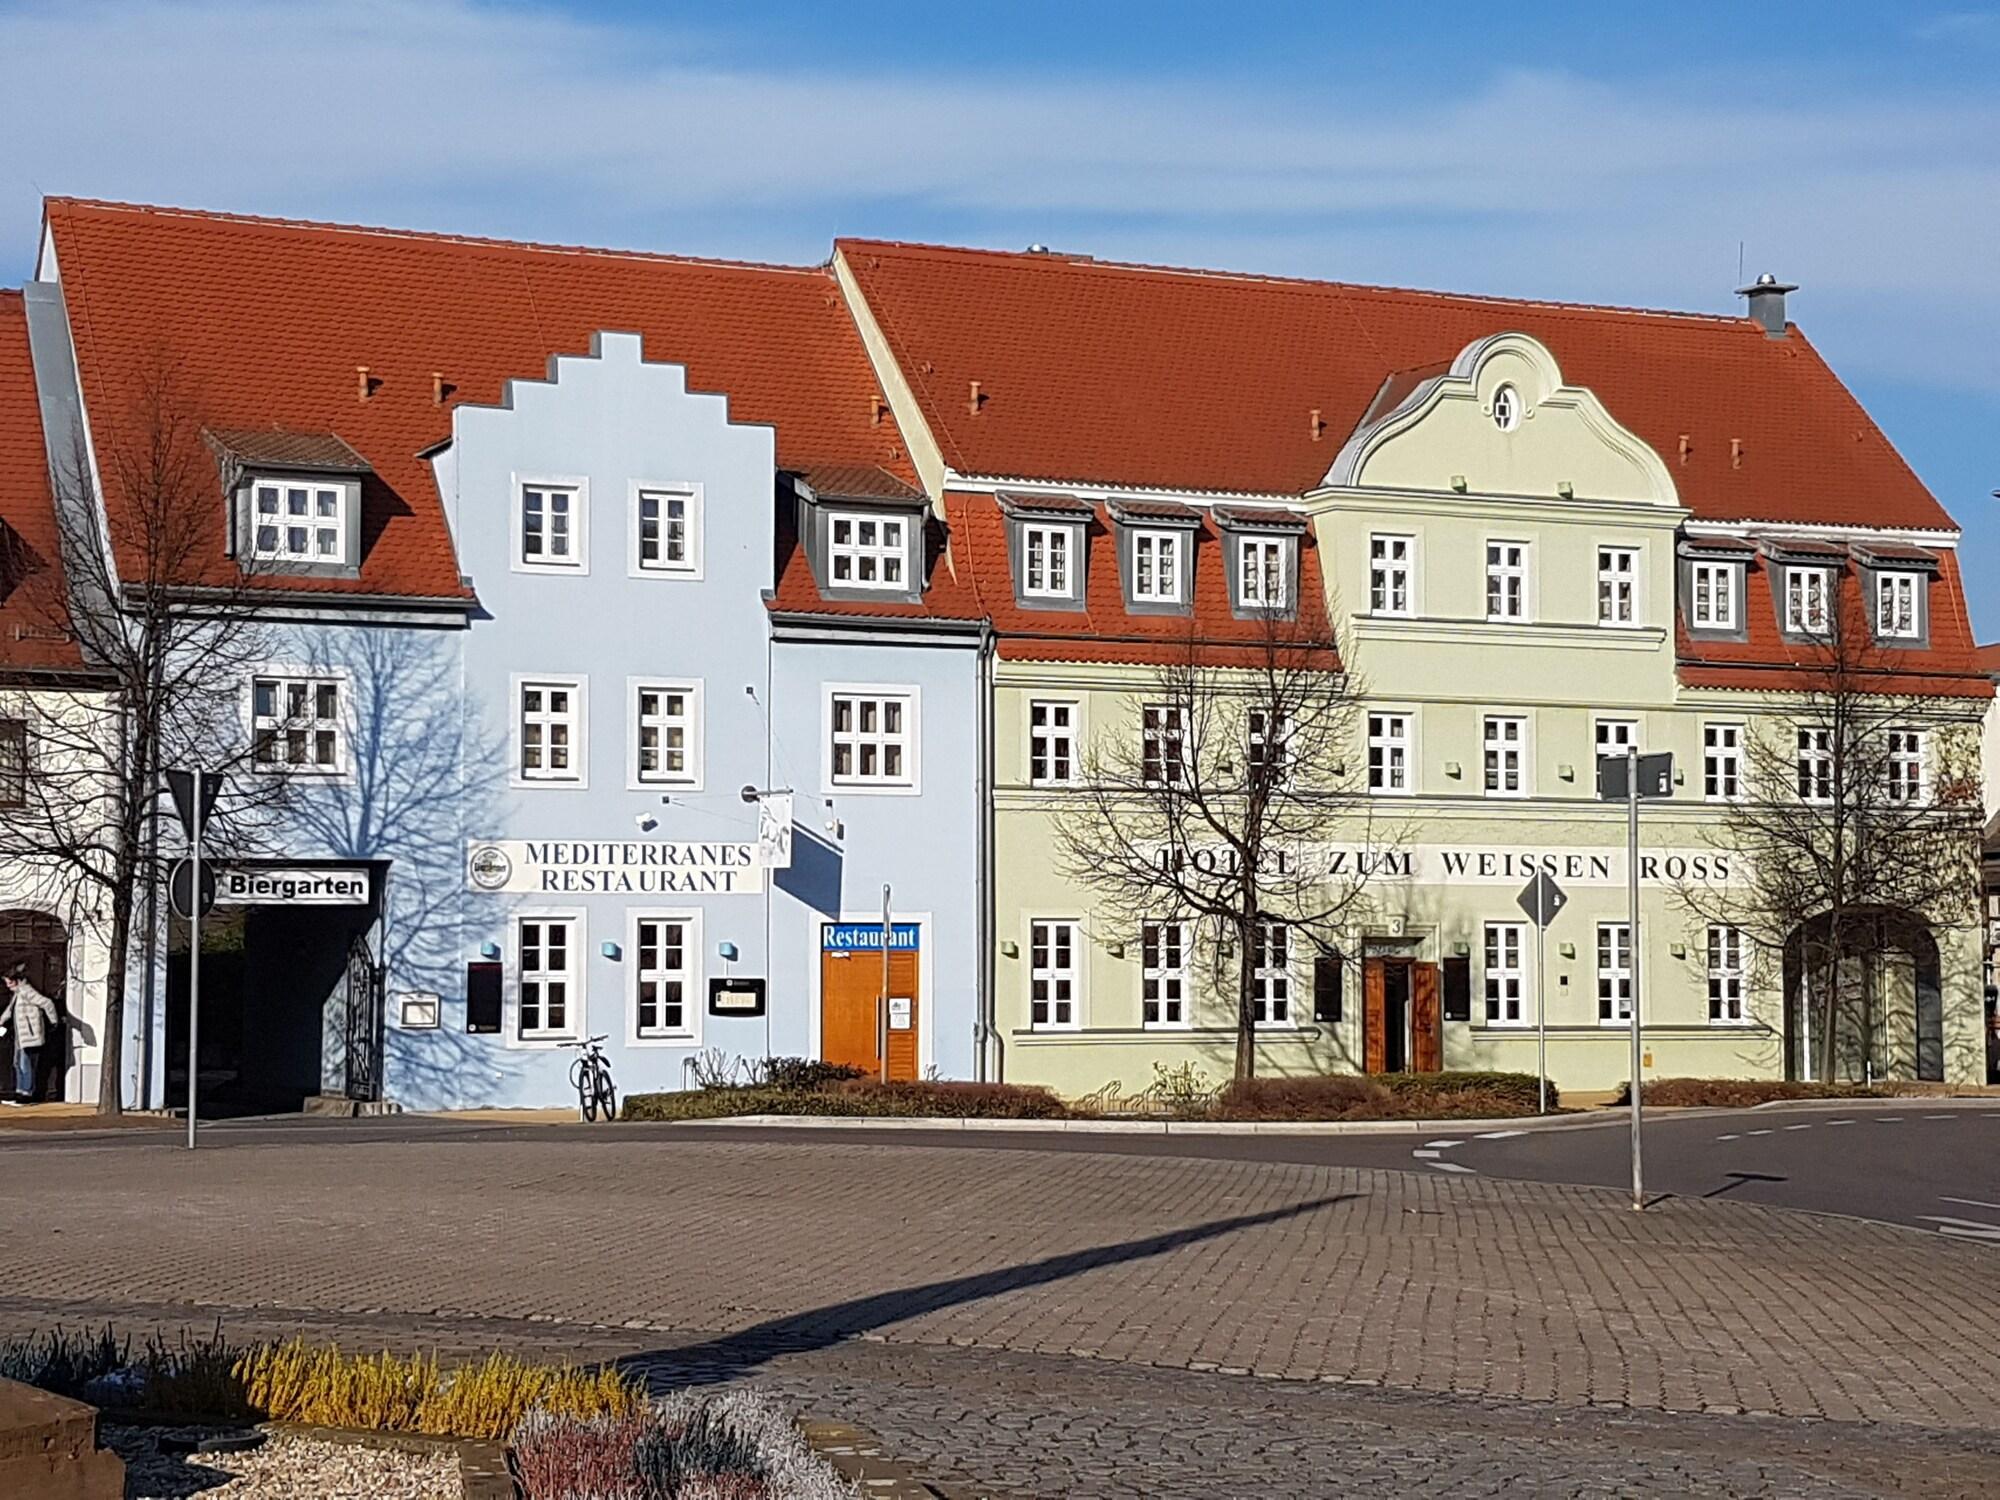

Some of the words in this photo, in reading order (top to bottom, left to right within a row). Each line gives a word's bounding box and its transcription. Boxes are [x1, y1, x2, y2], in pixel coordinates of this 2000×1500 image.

[524, 842, 751, 866] MEDITERRANES
[1328, 851, 1413, 875] ZUM
[1441, 852, 1610, 879] WEISSEN
[1640, 855, 1729, 880] ROSS
[230, 875, 363, 898] Biergarten
[540, 869, 737, 892] RESTAURANT
[1391, 919, 1402, 934] 3
